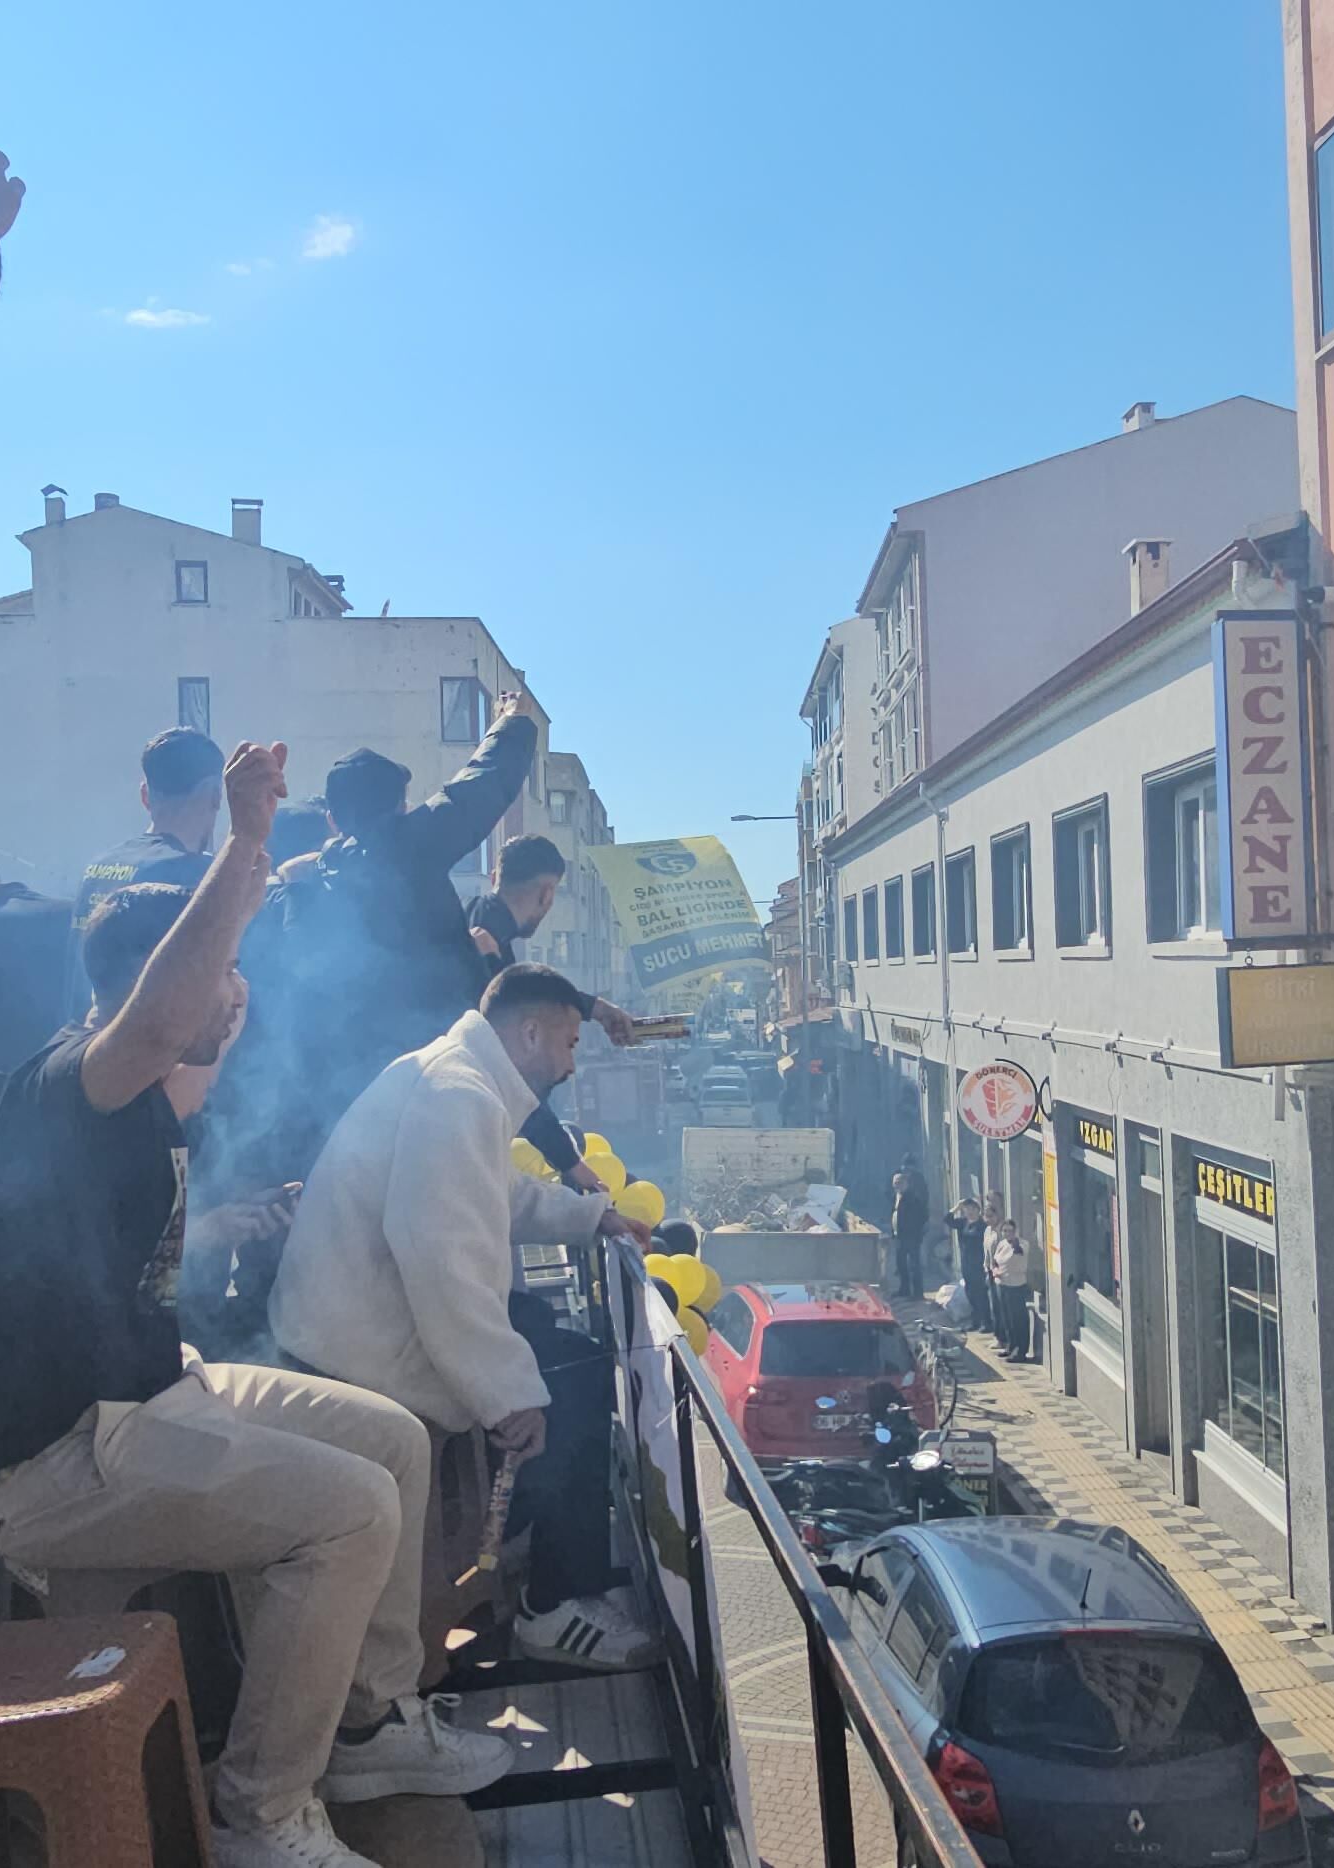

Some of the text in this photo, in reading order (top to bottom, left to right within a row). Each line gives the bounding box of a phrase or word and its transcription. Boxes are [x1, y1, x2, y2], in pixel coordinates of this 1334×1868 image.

[1239, 635, 1295, 924] ECZANE
[633, 878, 732, 900] ŞAMPİYON
[636, 909, 671, 926] BAL
[642, 931, 764, 973] SUCU MEHMET
[1079, 1120, 1113, 1154] IZGAR
[1198, 1162, 1275, 1216] ÇEŞİTLER
